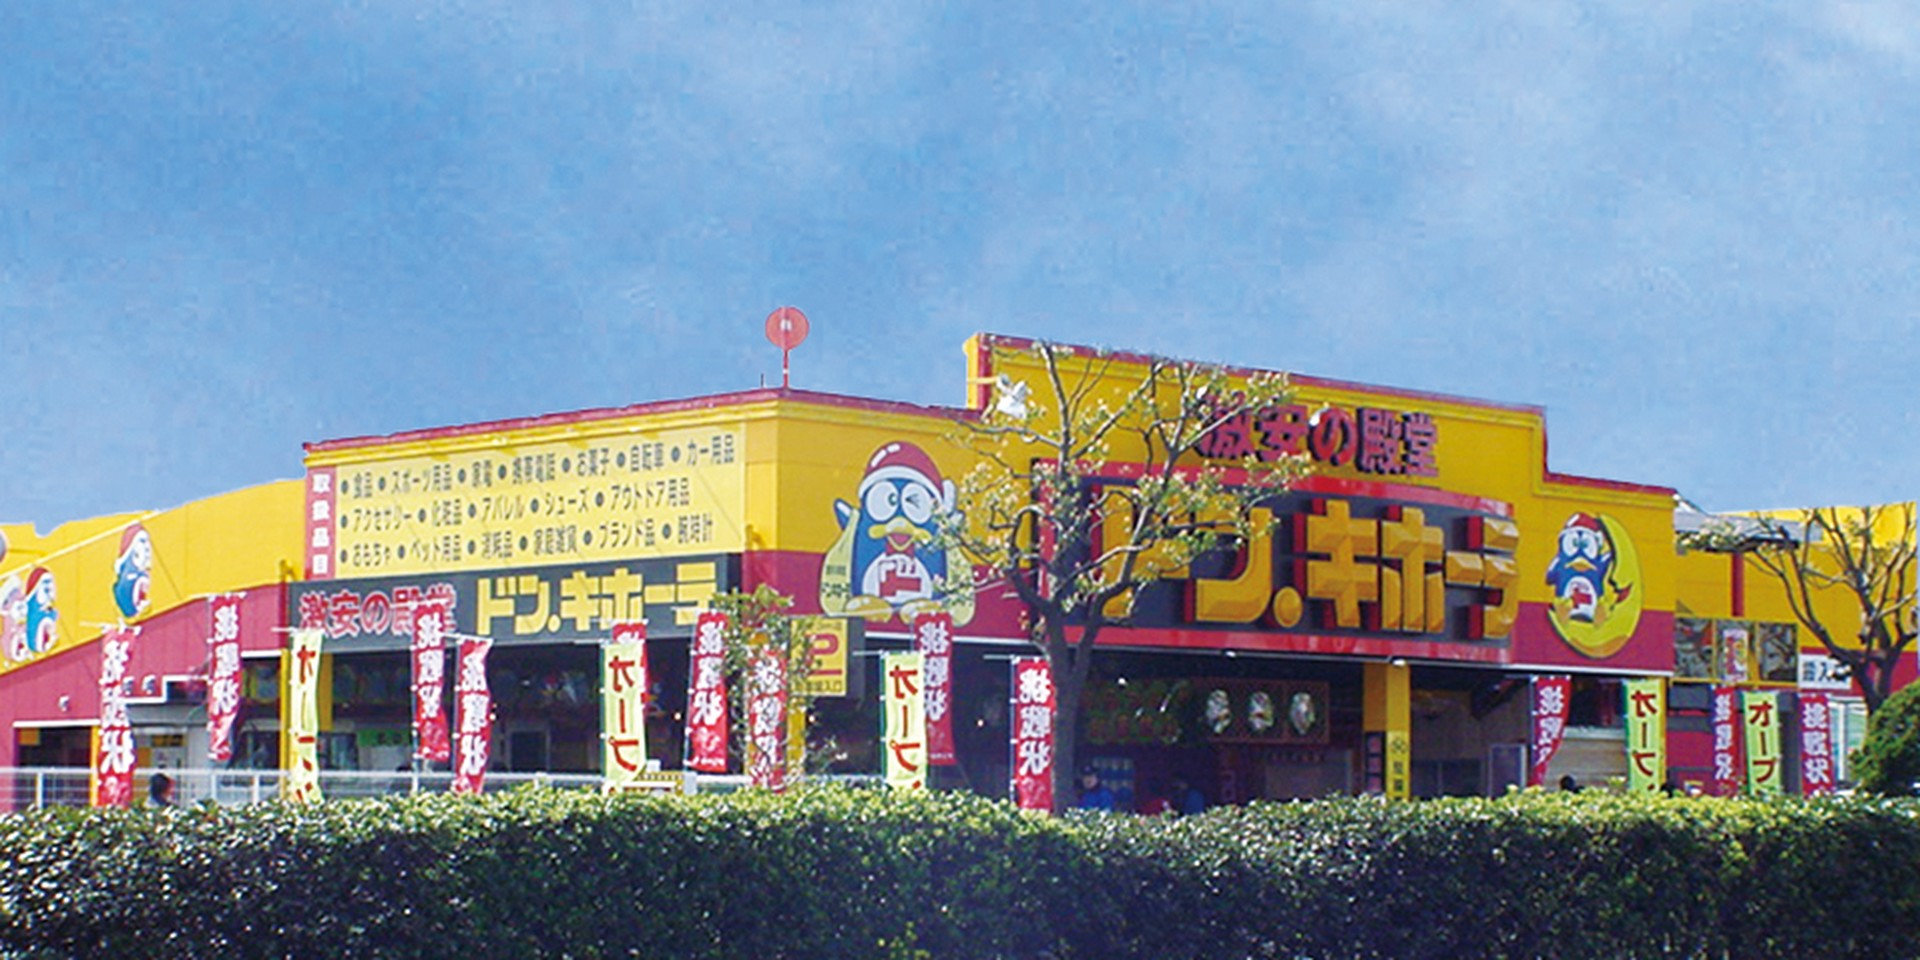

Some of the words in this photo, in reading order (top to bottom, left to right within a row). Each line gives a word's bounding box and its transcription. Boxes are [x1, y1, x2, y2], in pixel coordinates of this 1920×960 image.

[391, 464, 452, 494] スポーツ用品
[576, 448, 610, 477] お菓子
[630, 442, 665, 472] 自転車
[686, 434, 735, 466] カー用品
[481, 494, 525, 523] アパレル
[545, 486, 589, 516] シューズ
[610, 477, 690, 511] アウトドア用品
[352, 543, 392, 567] おもちゃ
[411, 534, 462, 562] ペット用品
[599, 518, 655, 549] ブランド品
